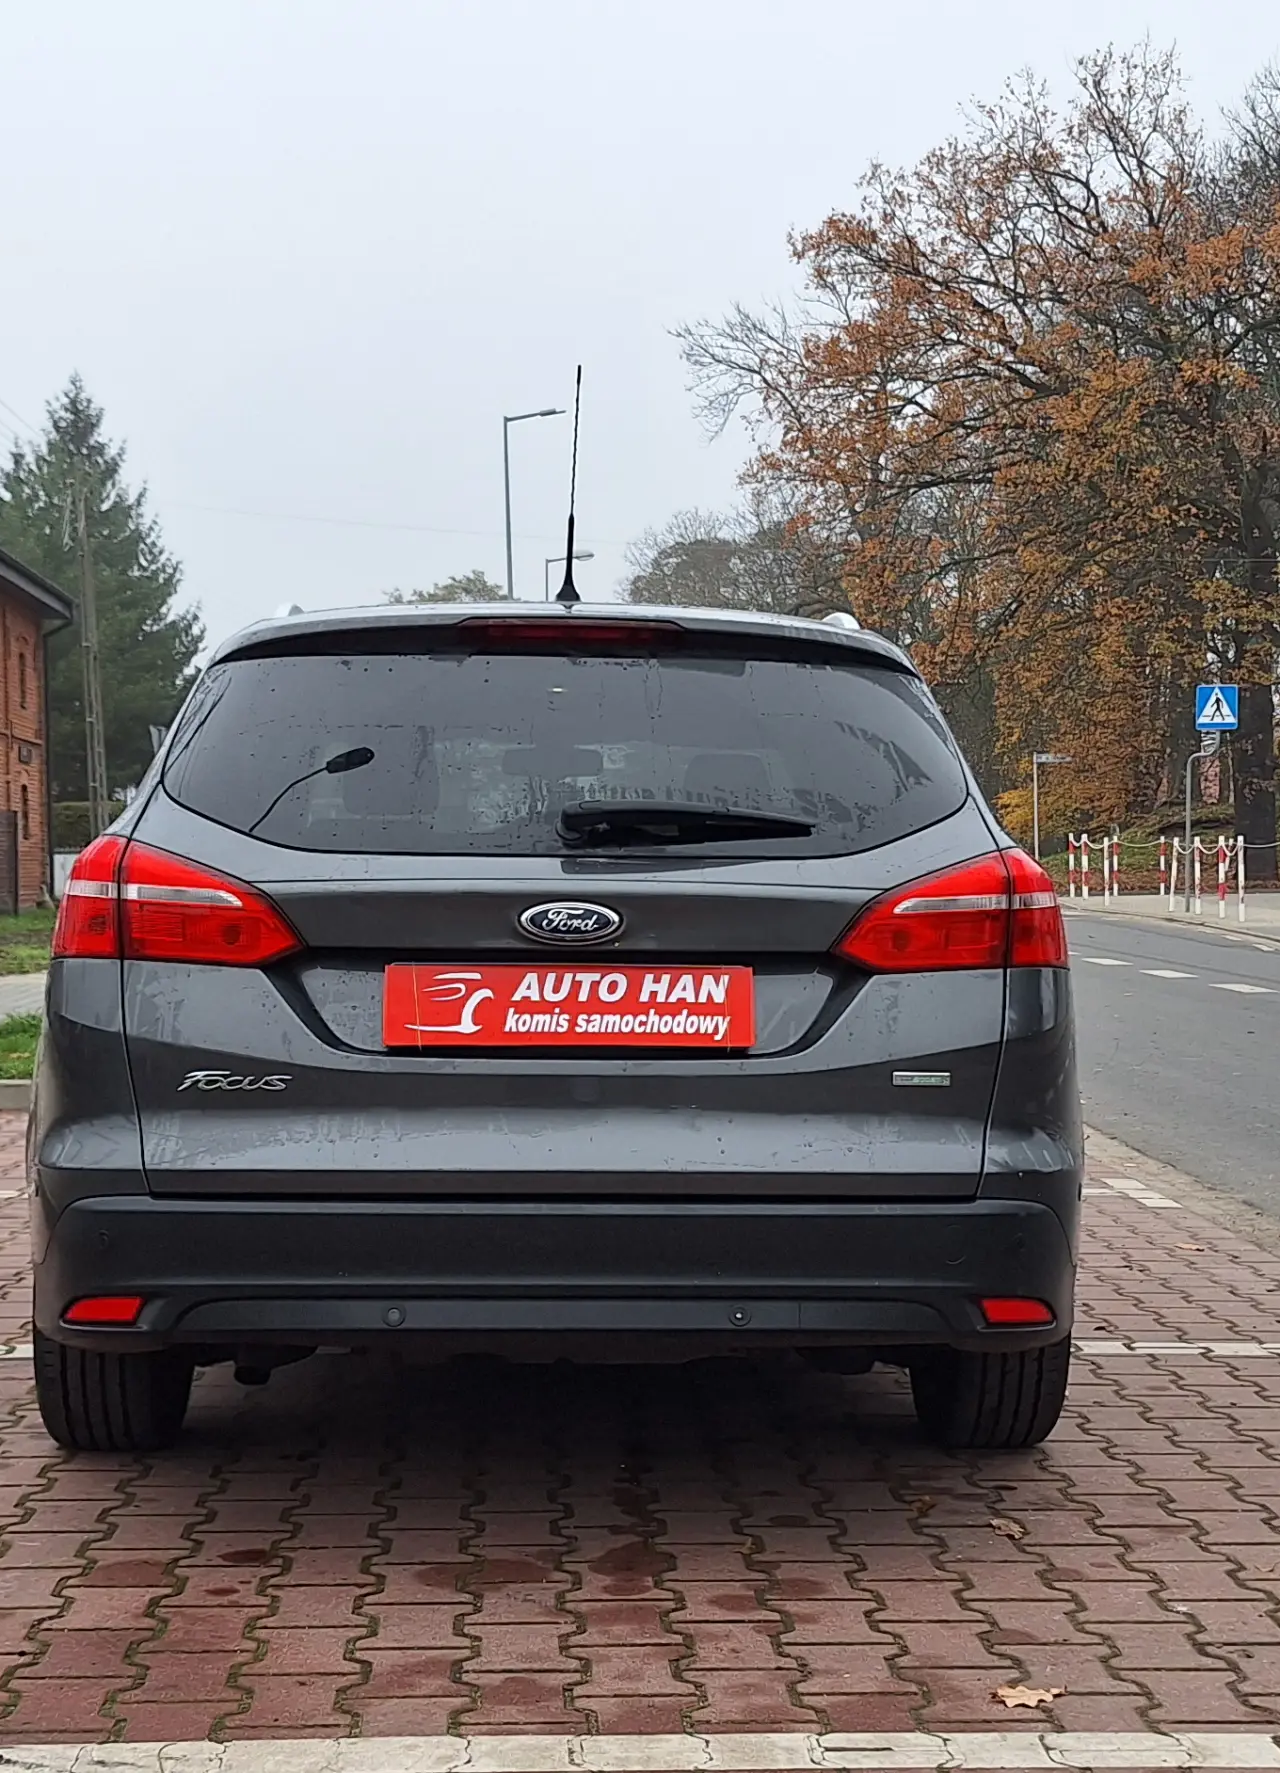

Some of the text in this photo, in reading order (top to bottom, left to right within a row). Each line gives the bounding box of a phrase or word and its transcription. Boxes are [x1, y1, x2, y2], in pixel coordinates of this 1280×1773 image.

[541, 908, 599, 931] Ford
[511, 972, 730, 1004] AUTO HAN
[504, 1008, 731, 1041] komis samochodowy
